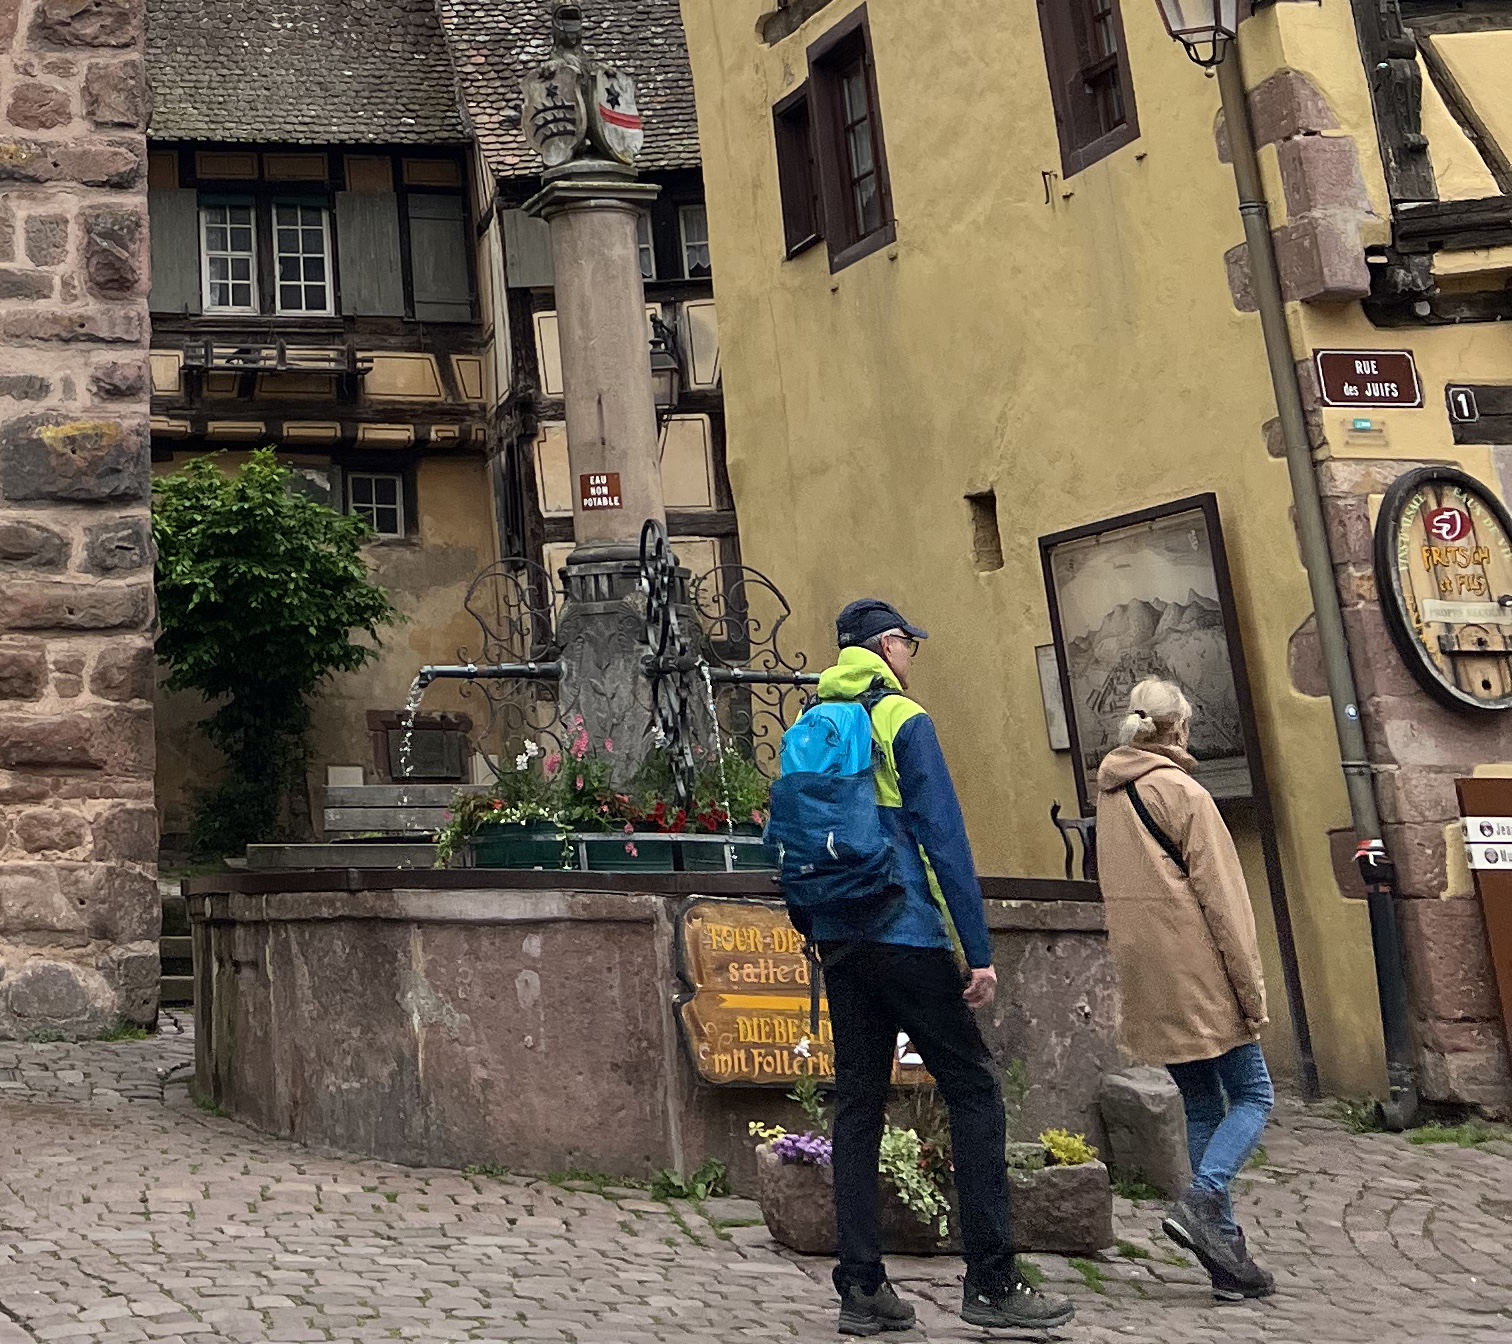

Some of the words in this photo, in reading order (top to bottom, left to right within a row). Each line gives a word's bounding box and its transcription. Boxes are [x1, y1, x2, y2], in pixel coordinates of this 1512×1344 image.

[1354, 360, 1379, 375] RUE
[1343, 382, 1360, 397] des
[1364, 382, 1399, 398] JUIFS
[1457, 393, 1470, 417] 1
[589, 475, 607, 485] EAU
[590, 486, 608, 496] NON
[583, 496, 620, 507] POTABLE
[1421, 545, 1490, 573] FRITSCH
[1455, 573, 1487, 596] FILS
[1496, 822, 1512, 836] Jea
[707, 923, 764, 952] TOUR
[771, 927, 806, 953] DE
[729, 958, 791, 984] salle
[795, 959, 810, 985] d
[713, 1048, 749, 1077] mit
[750, 1048, 835, 1077] Folterk
